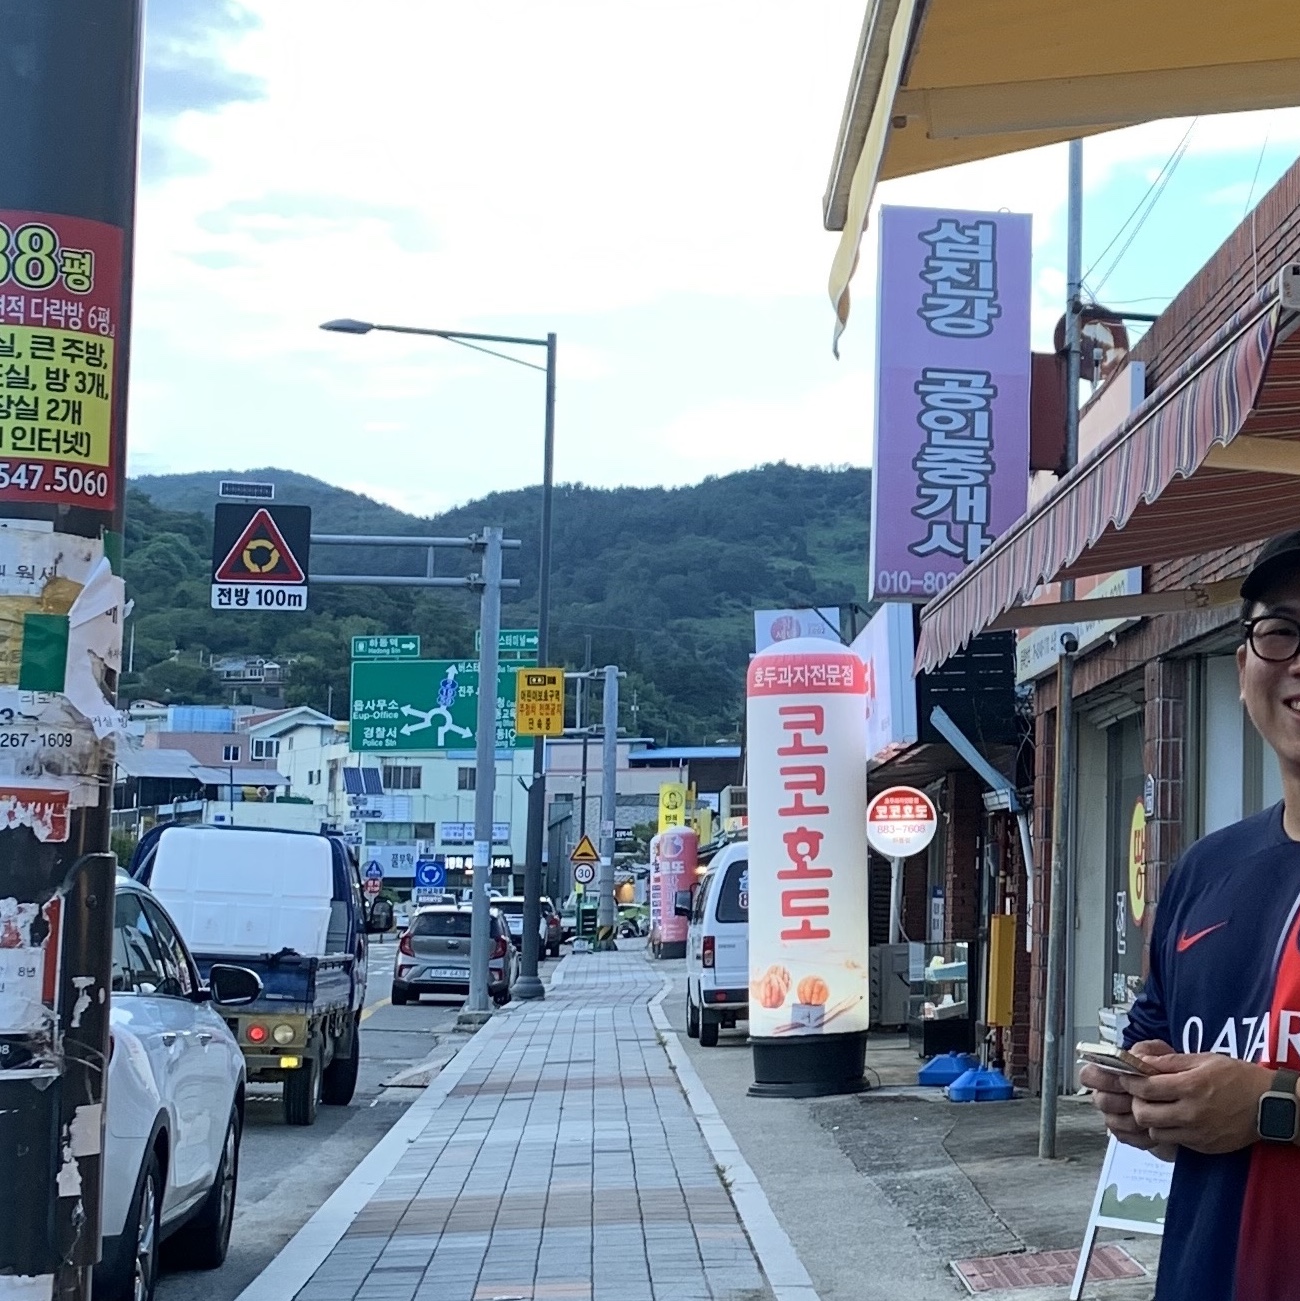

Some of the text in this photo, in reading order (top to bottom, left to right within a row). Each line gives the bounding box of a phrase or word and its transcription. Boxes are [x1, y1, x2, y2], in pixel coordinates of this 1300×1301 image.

[0, 222, 95, 295] 8평
[918, 219, 1002, 338] 섬진강
[31, 297, 84, 330] 다락방
[30, 335, 55, 360] 큰
[62, 338, 107, 370] 주방,
[0, 364, 109, 400] 실, 방 3개,
[47, 399, 82, 425] 2개
[909, 368, 998, 564] 공인중개사
[217, 587, 302, 606] 전방 100m
[499, 634, 526, 647] 스터미널
[754, 664, 854, 688] 호두과자전문점
[458, 686, 474, 697] 진주
[354, 700, 399, 711] 읍사무소
[353, 711, 399, 720] Eup-Office
[1, 733, 73, 747] 267-1609
[364, 727, 397, 738] 경찰서
[363, 739, 397, 747] Police Stn
[875, 805, 928, 819] 코코호도
[777, 704, 833, 941] 코코호도
[578, 868, 590, 878] 30
